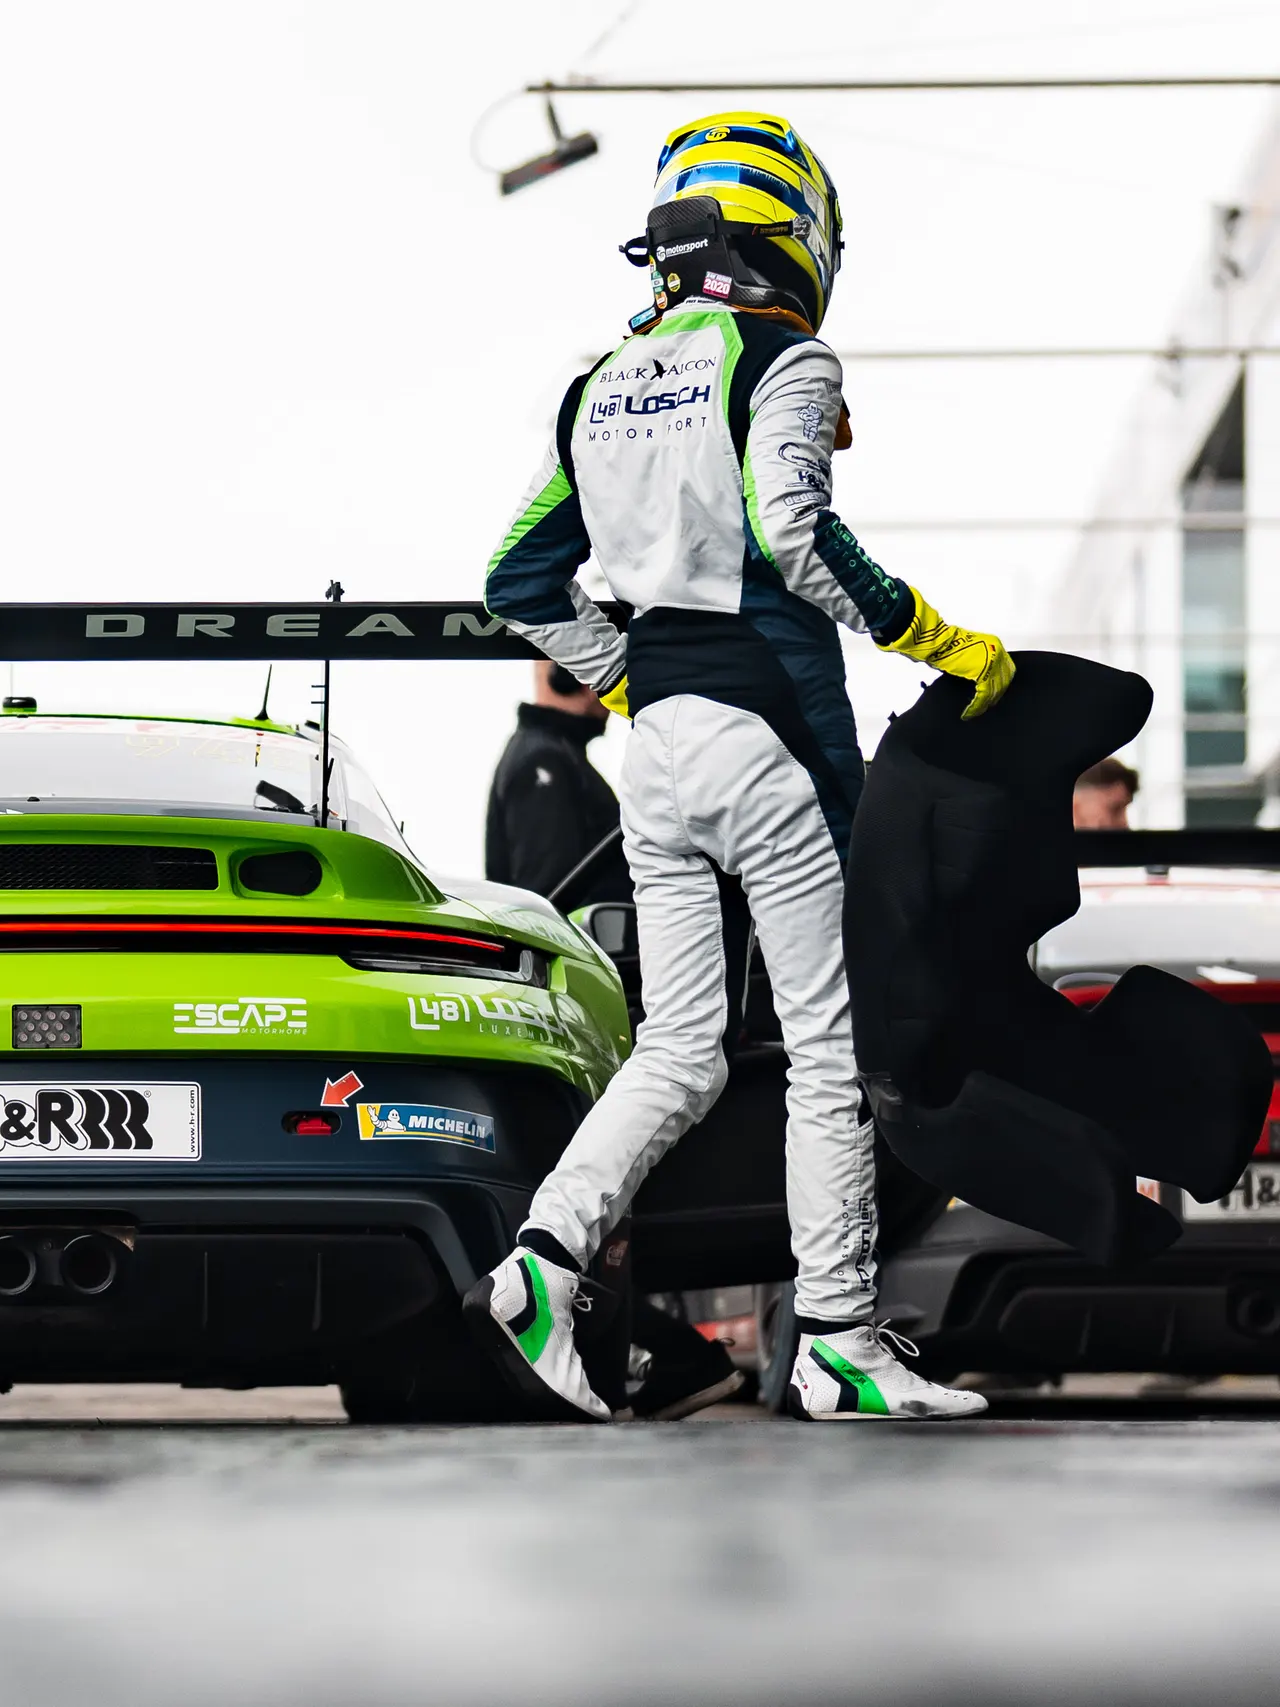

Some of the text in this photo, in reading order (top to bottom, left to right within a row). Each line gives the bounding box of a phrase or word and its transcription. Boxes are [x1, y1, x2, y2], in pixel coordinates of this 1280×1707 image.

[666, 239, 708, 257] motorsport
[703, 278, 731, 295] 2020
[599, 368, 648, 383] BLACK
[624, 385, 711, 415] LOSCH
[173, 997, 307, 1034] ESCAPE
[240, 1027, 308, 1036] MOTORHOME
[188, 1089, 196, 1153] www.h-r.com
[407, 1114, 487, 1140] MICHELIN
